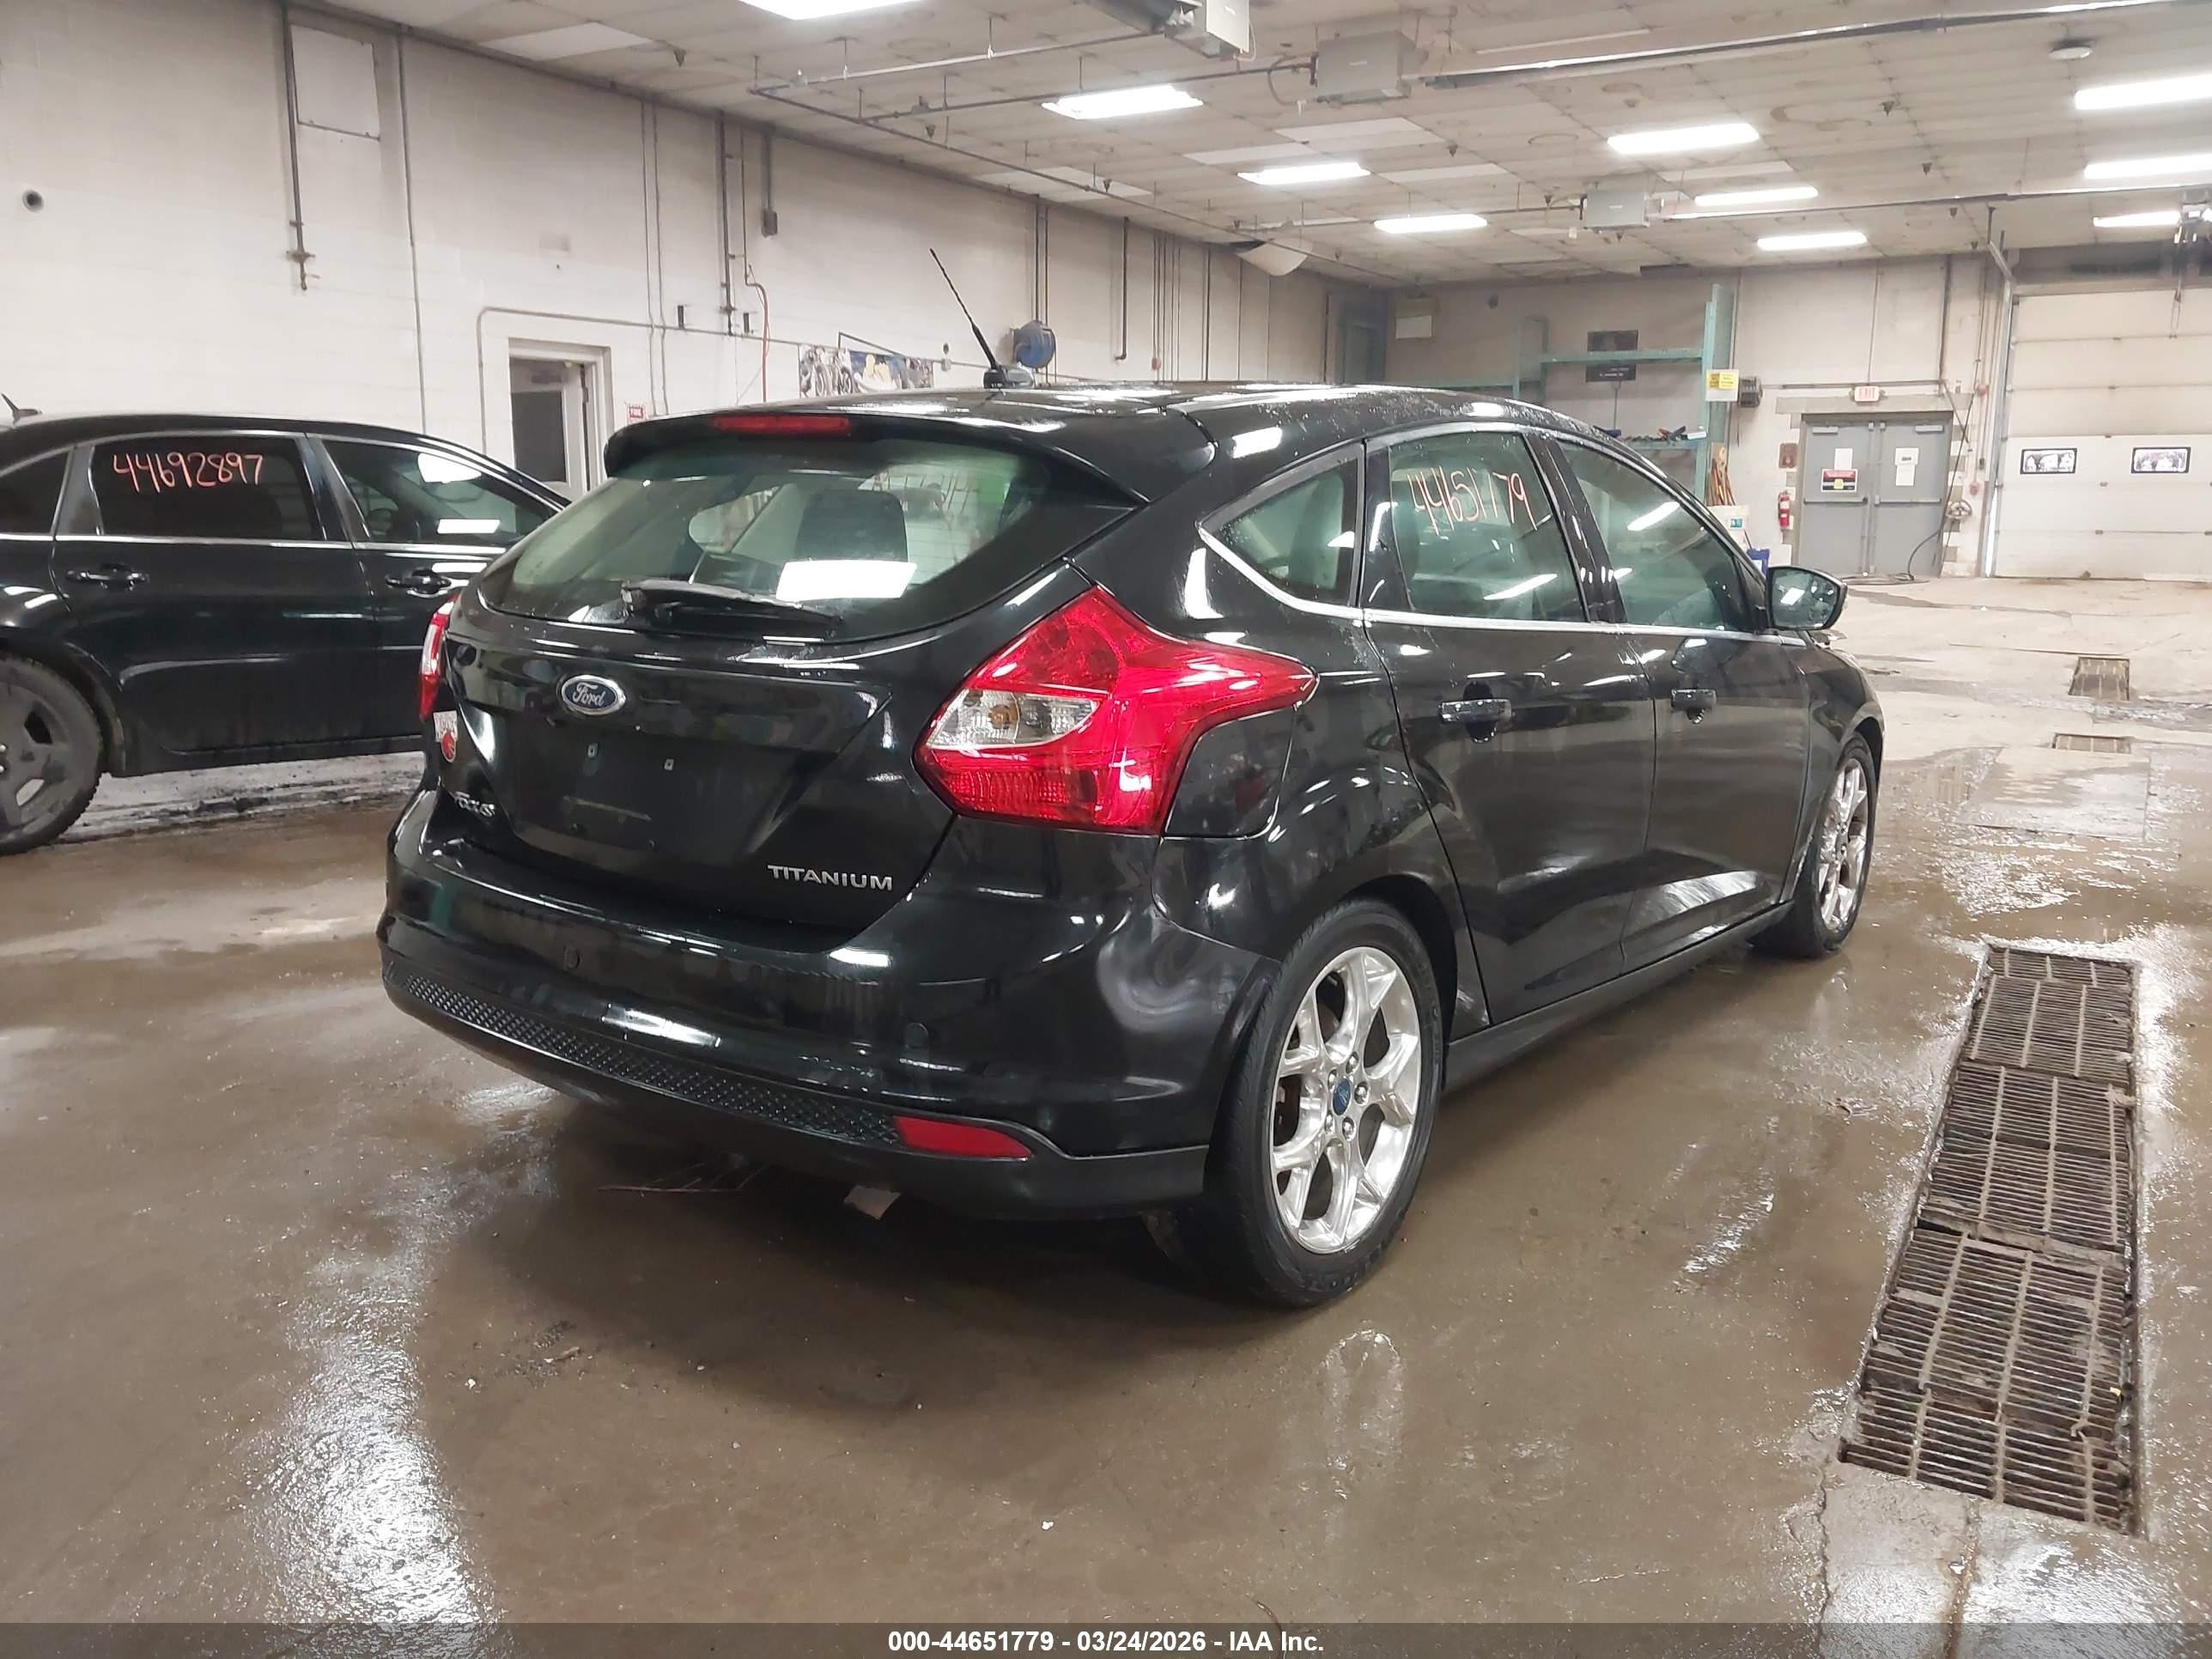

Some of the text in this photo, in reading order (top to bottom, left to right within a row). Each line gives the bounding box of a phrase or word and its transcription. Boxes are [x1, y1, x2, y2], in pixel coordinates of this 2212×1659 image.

[113, 452, 263, 493] 44692897
[1407, 465, 1538, 536] 44651179
[572, 682, 606, 706] Ford
[767, 865, 893, 890] TITANIUM
